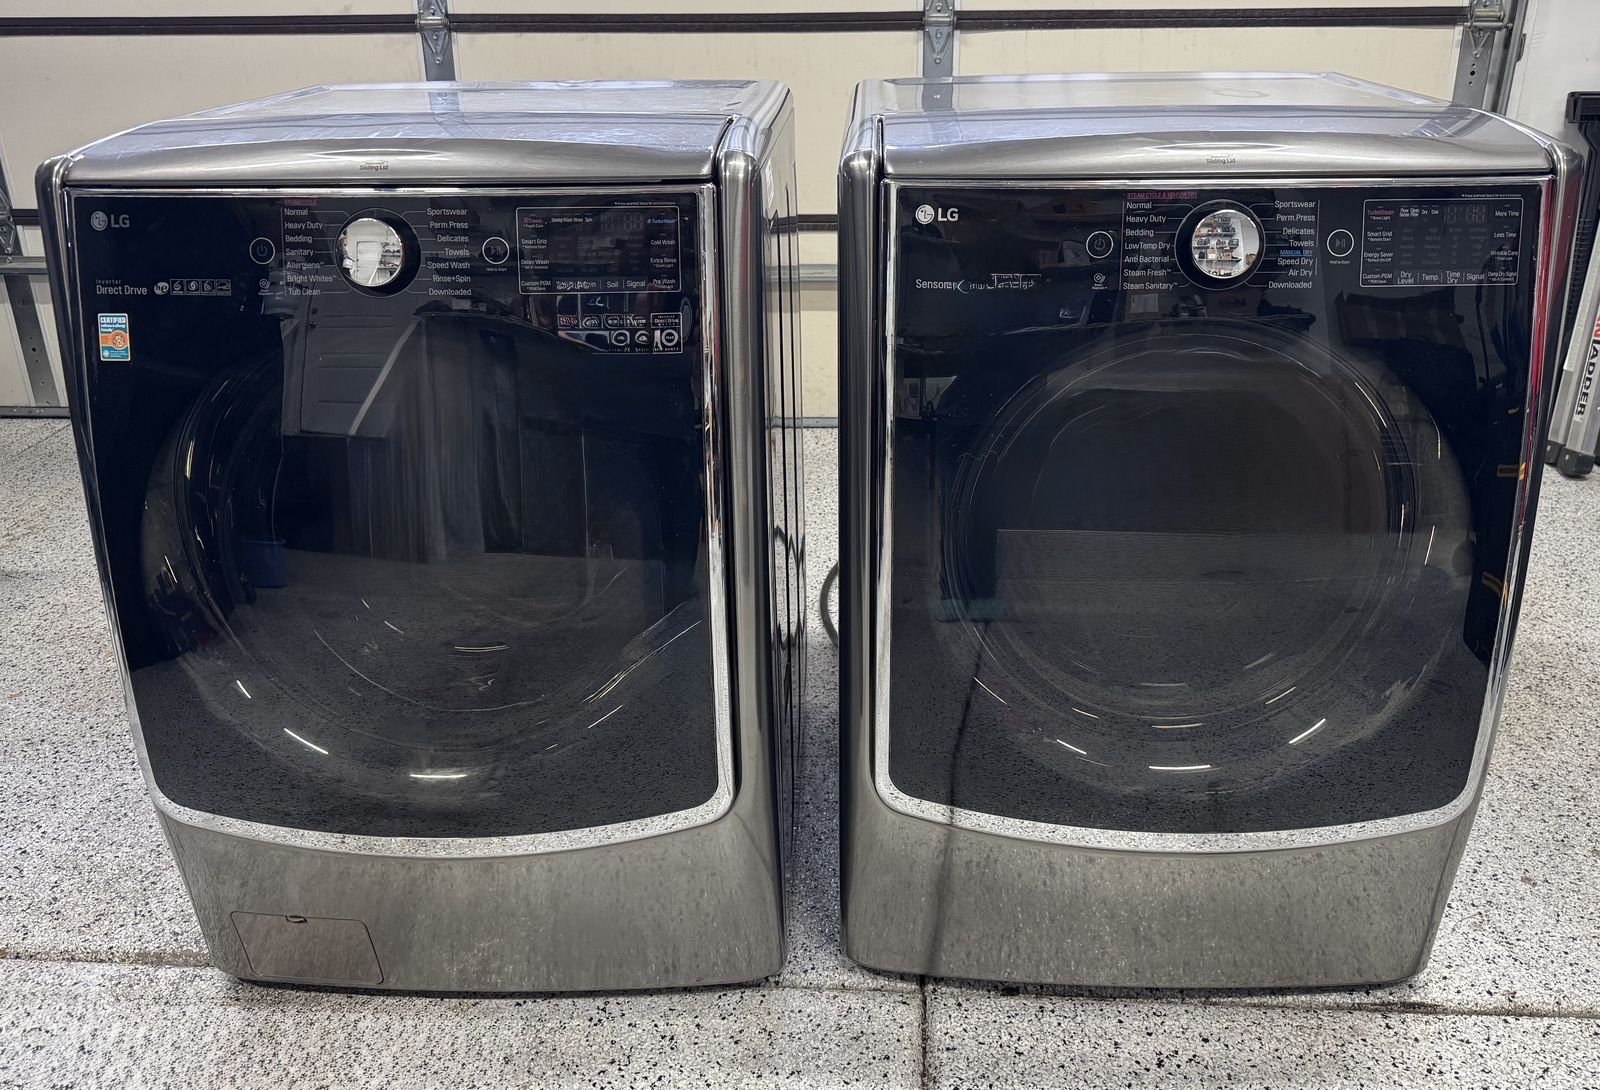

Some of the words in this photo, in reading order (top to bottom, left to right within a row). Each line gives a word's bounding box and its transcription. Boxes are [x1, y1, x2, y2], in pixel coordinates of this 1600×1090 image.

[1275, 200, 1316, 209] Sportswear
[426, 208, 468, 216] Sportswear
[938, 208, 958, 222] LG
[110, 214, 130, 228] LG
[1126, 215, 1148, 223] Heavy
[1150, 215, 1166, 223] Duty
[1125, 229, 1154, 237] Bedding
[285, 235, 313, 243] Bedding
[1158, 242, 1170, 250] Dry
[285, 248, 314, 256] Sanitary
[1277, 258, 1299, 266] Speed
[1301, 258, 1313, 266] Dry
[1300, 269, 1312, 277] Dry
[287, 274, 308, 283] Bright
[432, 275, 471, 283] Rinse+Spin
[96, 285, 122, 295] Direct
[124, 285, 147, 295] Drive
